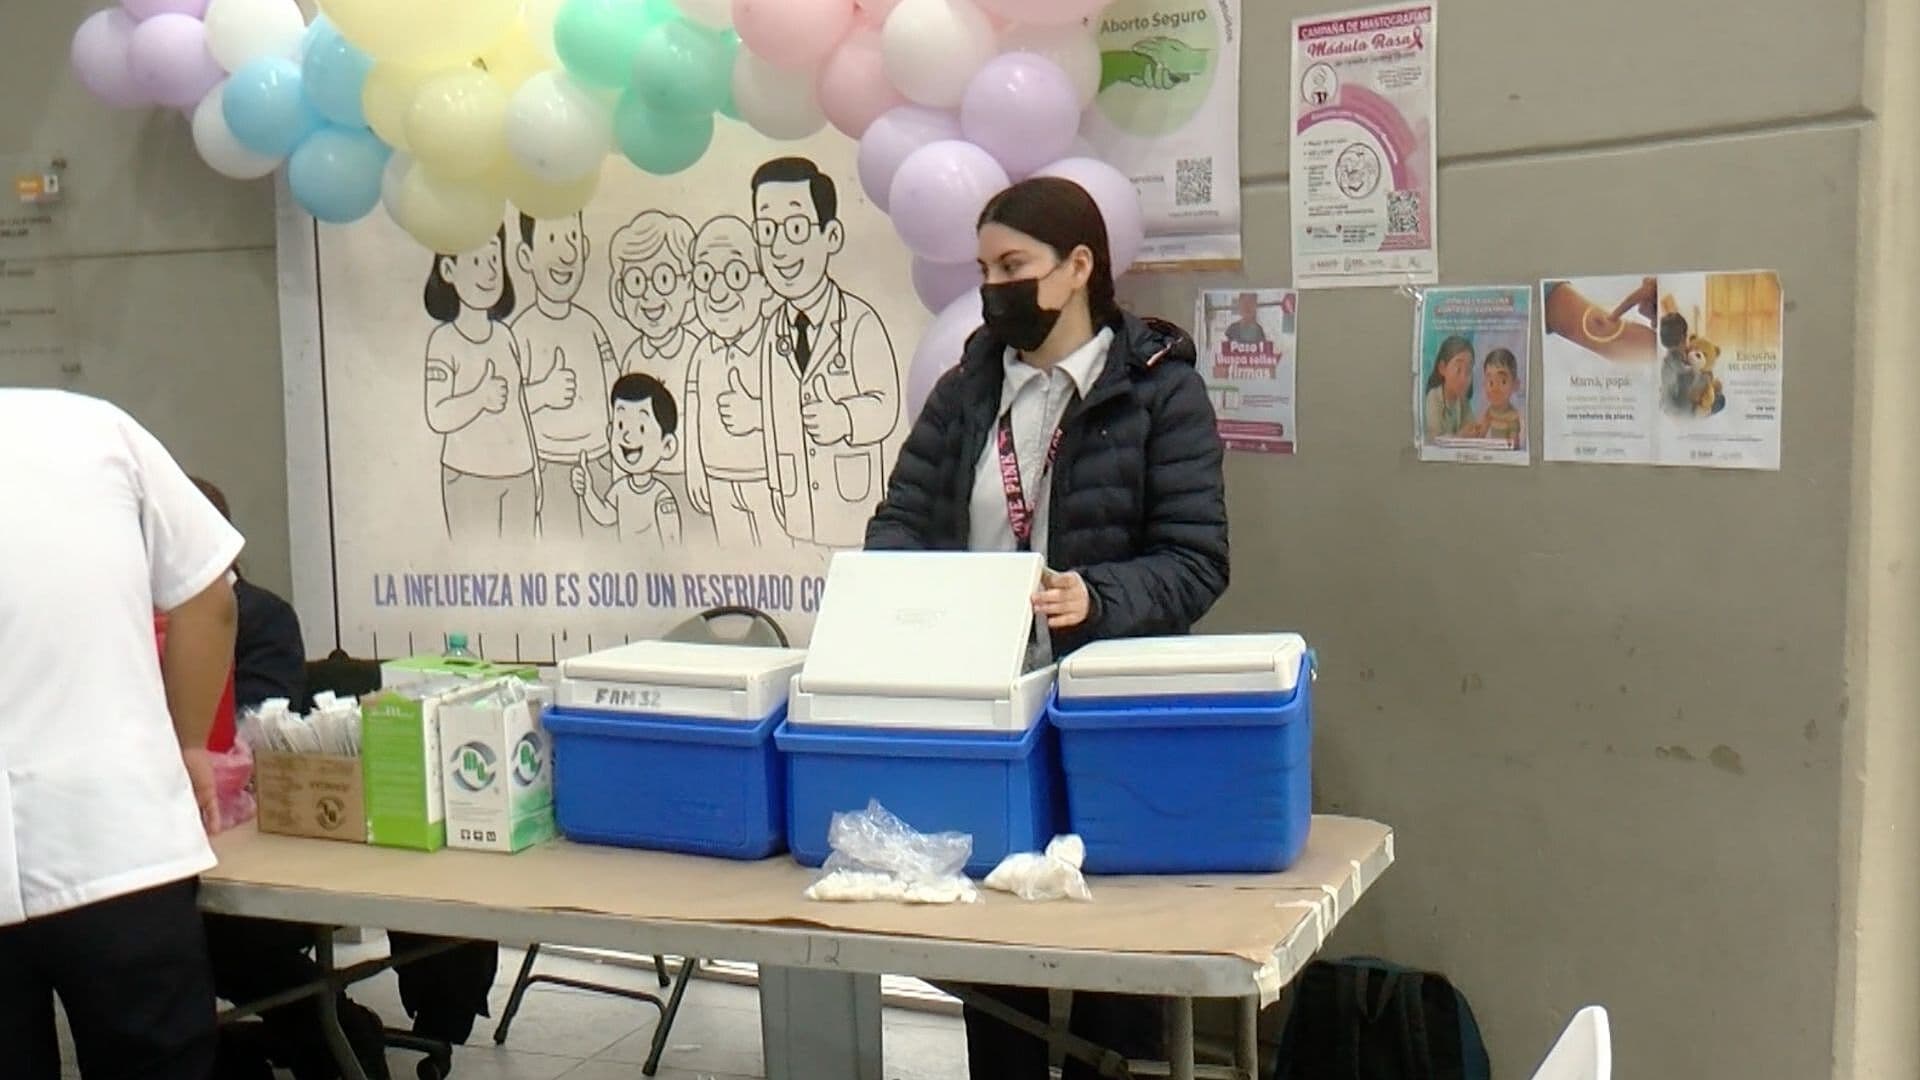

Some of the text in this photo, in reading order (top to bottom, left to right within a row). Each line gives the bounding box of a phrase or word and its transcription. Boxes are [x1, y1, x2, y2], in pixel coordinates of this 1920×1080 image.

[1101, 17, 1149, 33] Aborto
[1152, 8, 1206, 28] Seguro
[1301, 23, 1345, 39] CAMPAÑA
[1346, 21, 1358, 33] DE
[1230, 341, 1257, 354] Paso
[1227, 365, 1271, 379] firmas
[1000, 453, 1021, 495] PINK
[374, 573, 398, 606] LA
[403, 573, 513, 607] INFLUENZA
[520, 573, 547, 607] NO
[555, 573, 580, 607] ES
[588, 572, 638, 607] SOLO
[646, 573, 676, 607] UN
[682, 574, 793, 612] RESFRIADO
